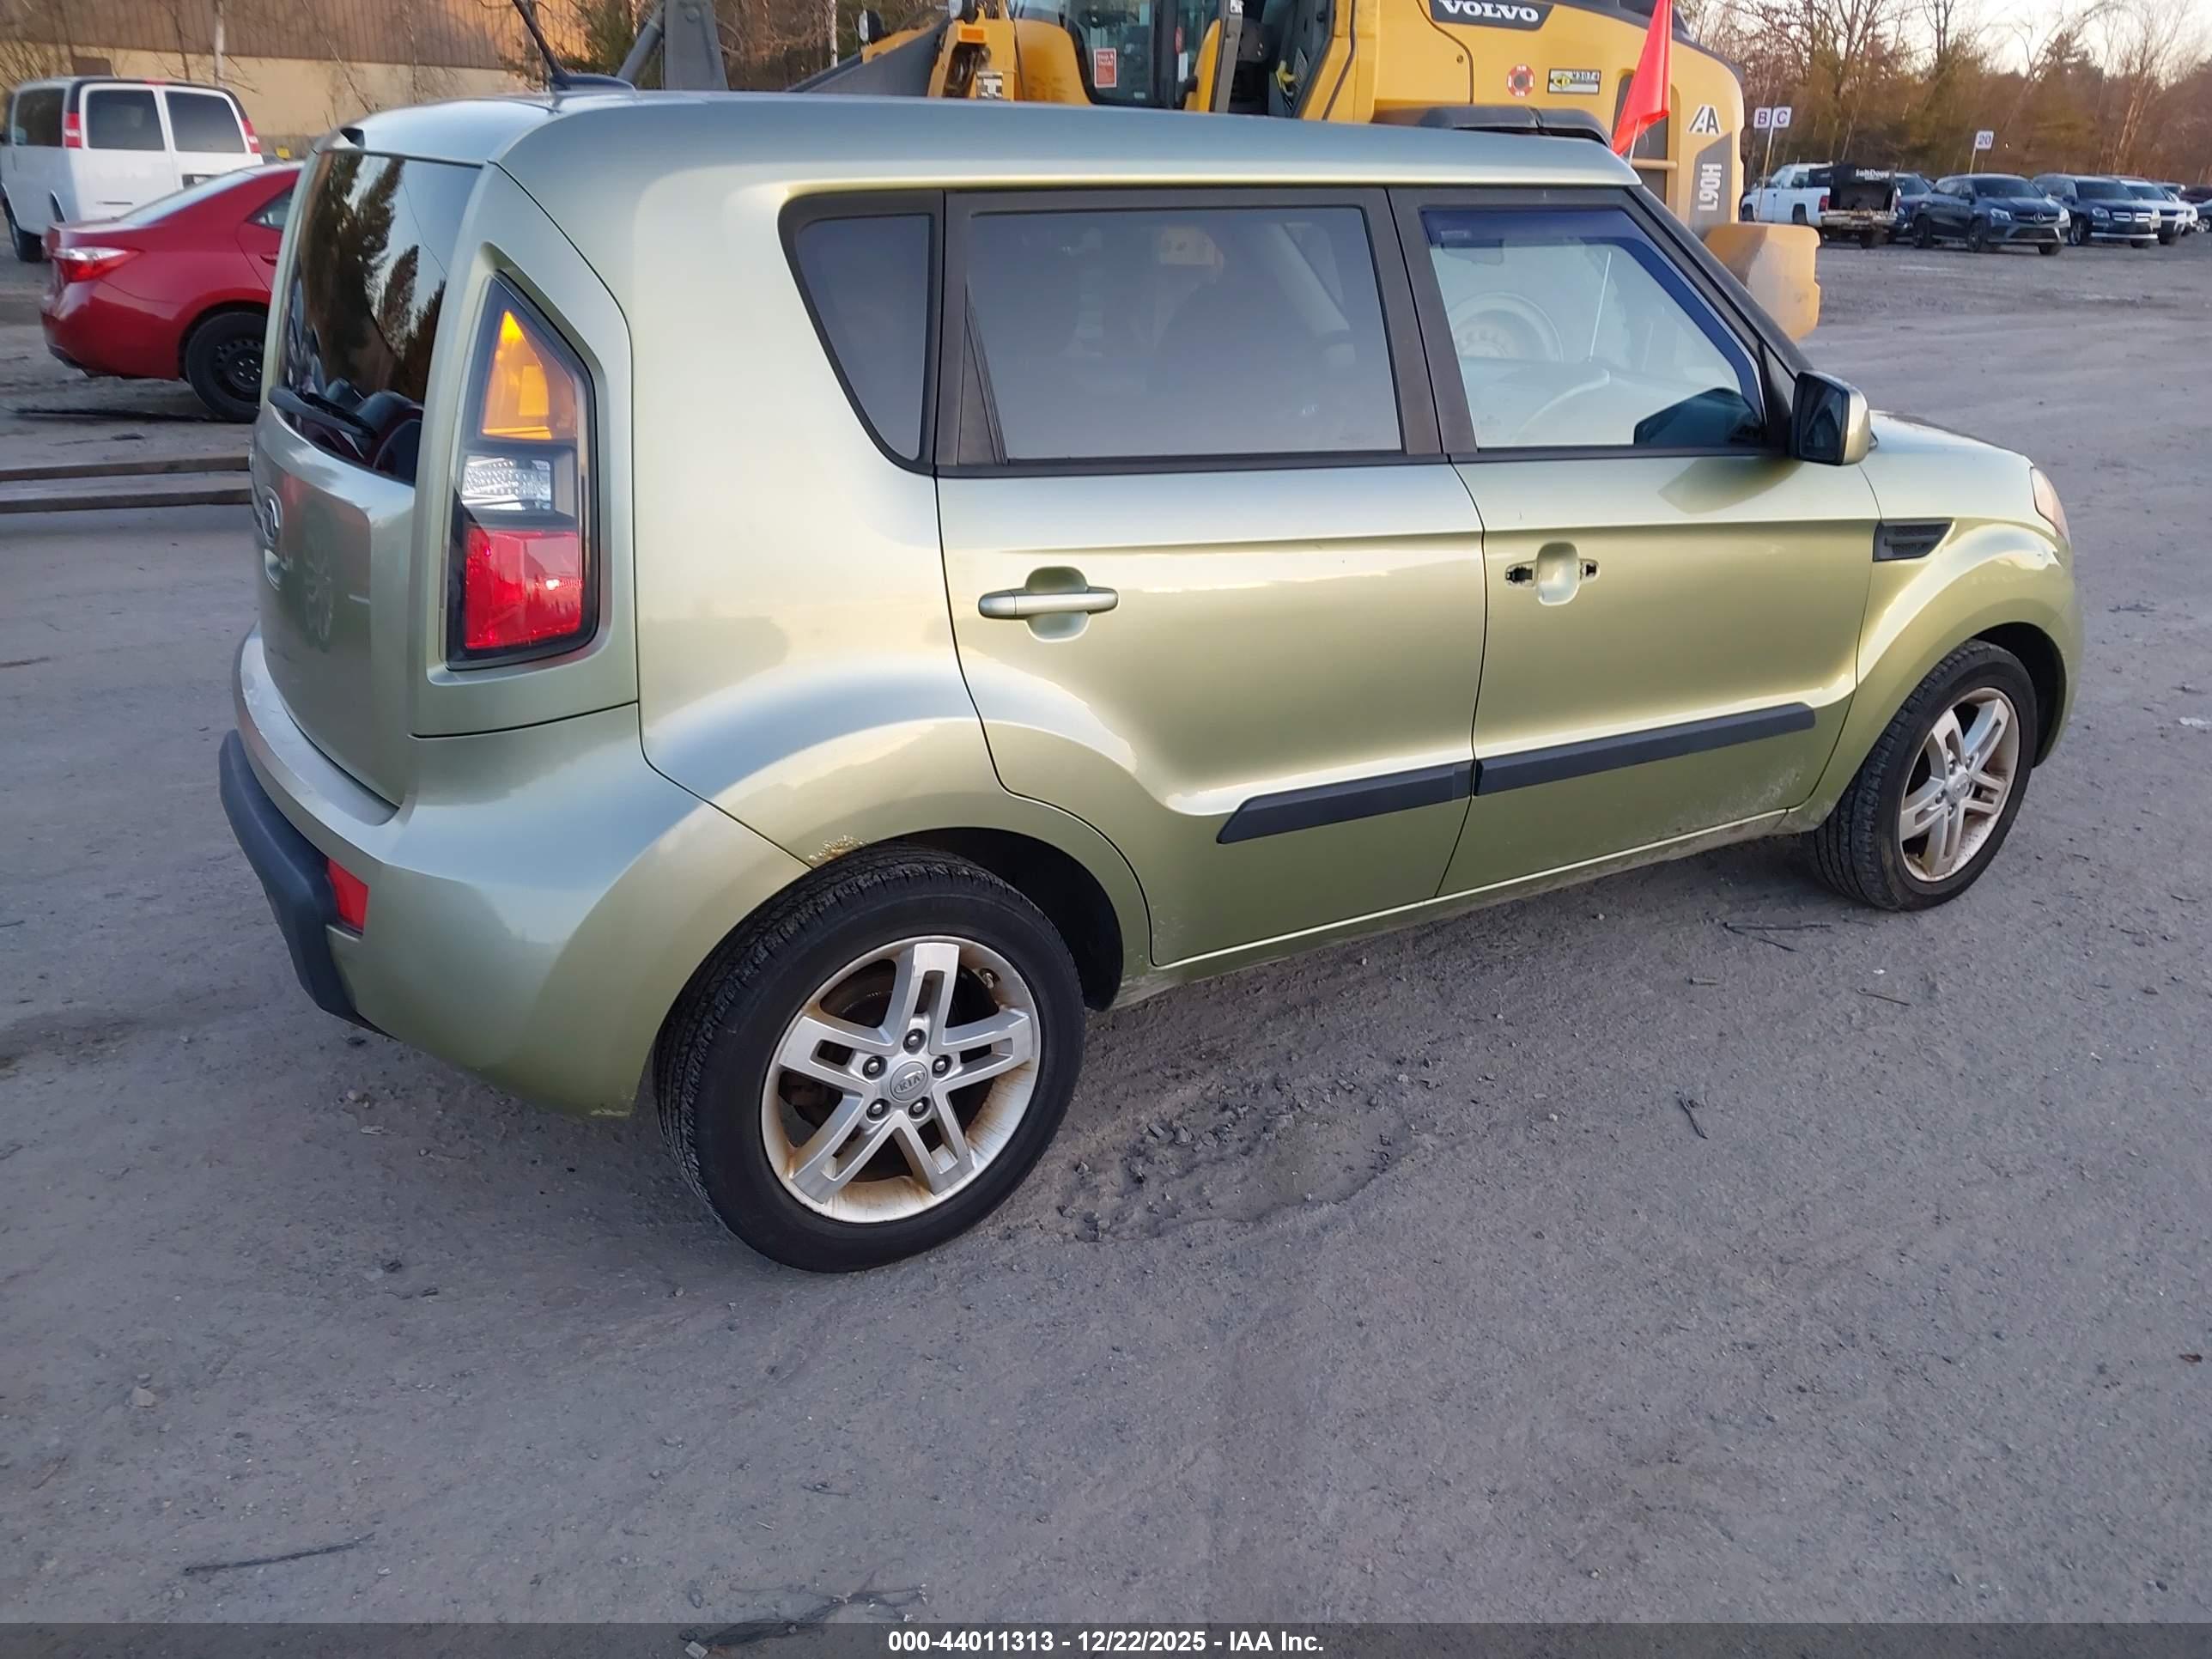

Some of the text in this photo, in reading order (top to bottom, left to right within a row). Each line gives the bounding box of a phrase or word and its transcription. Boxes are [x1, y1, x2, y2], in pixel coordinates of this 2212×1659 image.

[1438, 0, 1539, 22] VOLVO
[1758, 112, 1767, 125] B
[1777, 111, 1788, 125] C
[1978, 135, 1991, 145] 20
[1698, 163, 1723, 211] L90H
[897, 1074, 921, 1091] KIA
